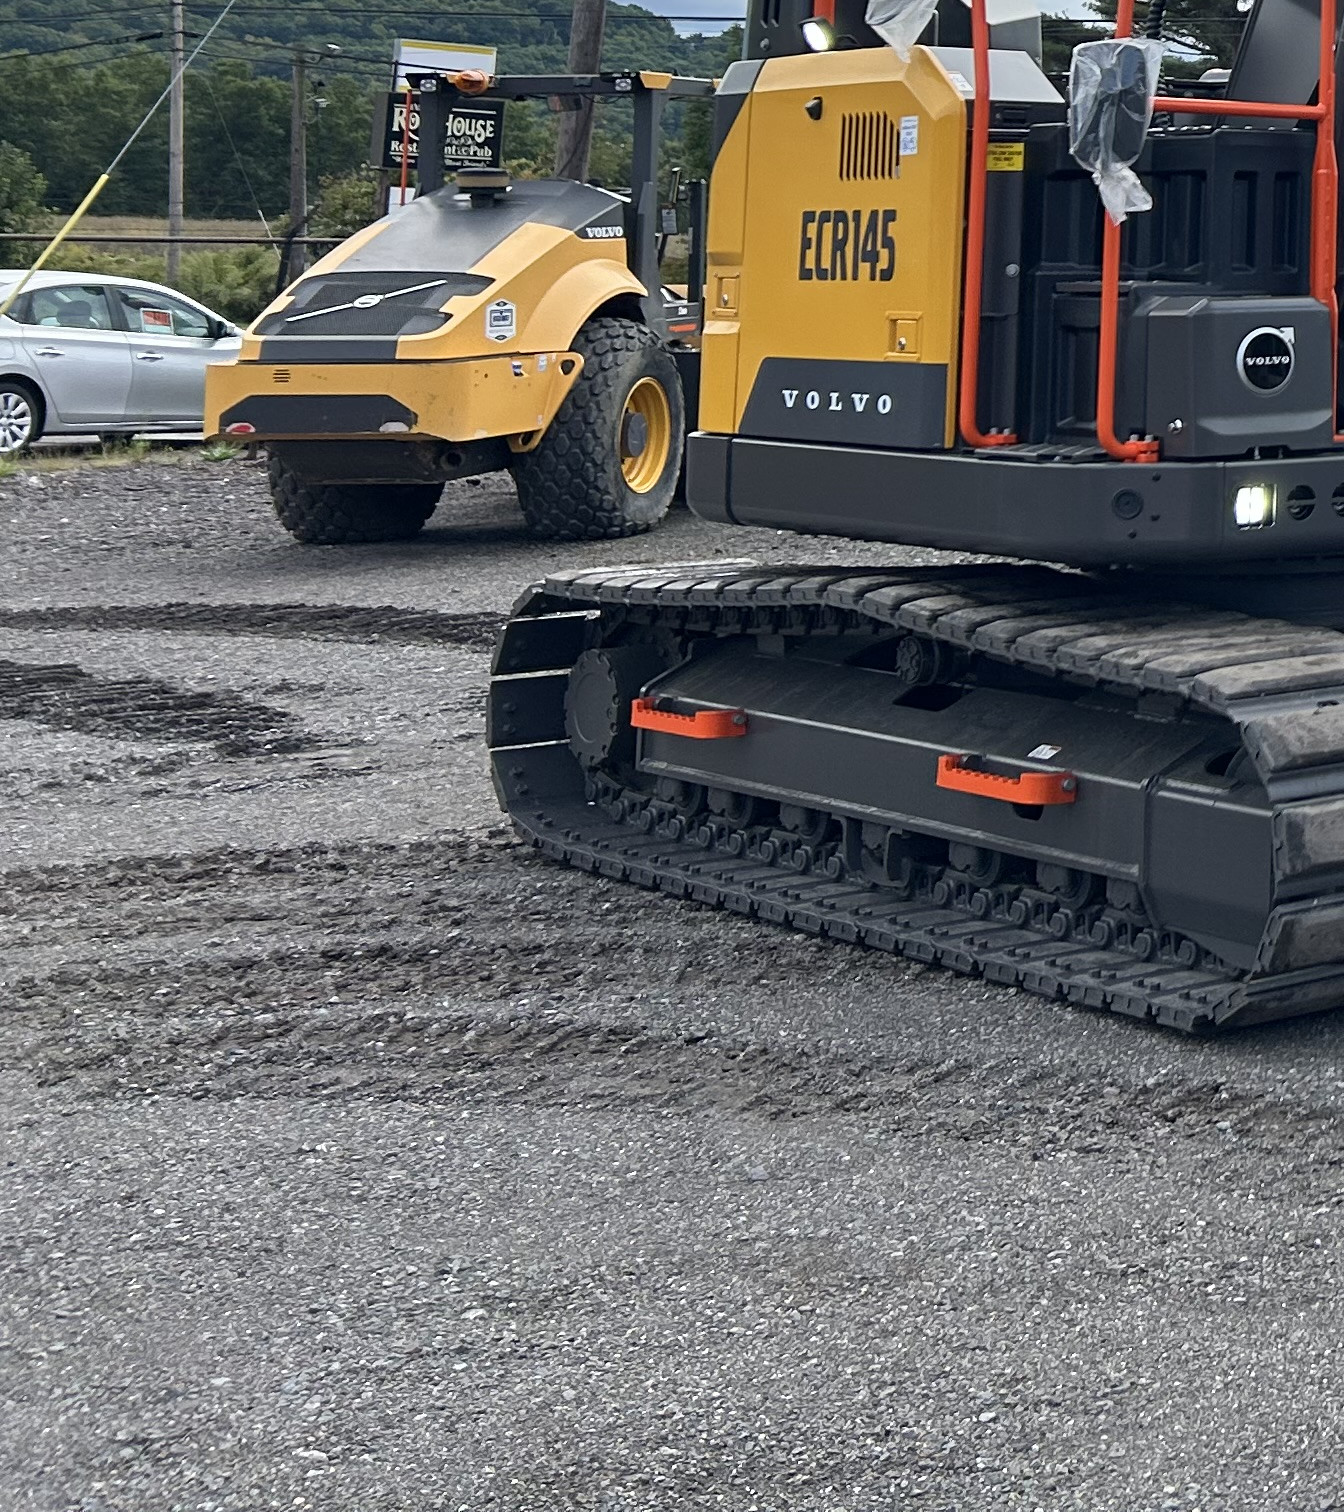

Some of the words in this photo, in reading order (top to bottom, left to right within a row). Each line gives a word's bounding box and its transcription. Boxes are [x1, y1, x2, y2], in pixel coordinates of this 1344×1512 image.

[586, 226, 624, 238] VOLVO
[799, 209, 897, 282] ECR145
[1245, 355, 1290, 366] VOLVO
[782, 389, 893, 414] VOLVO
